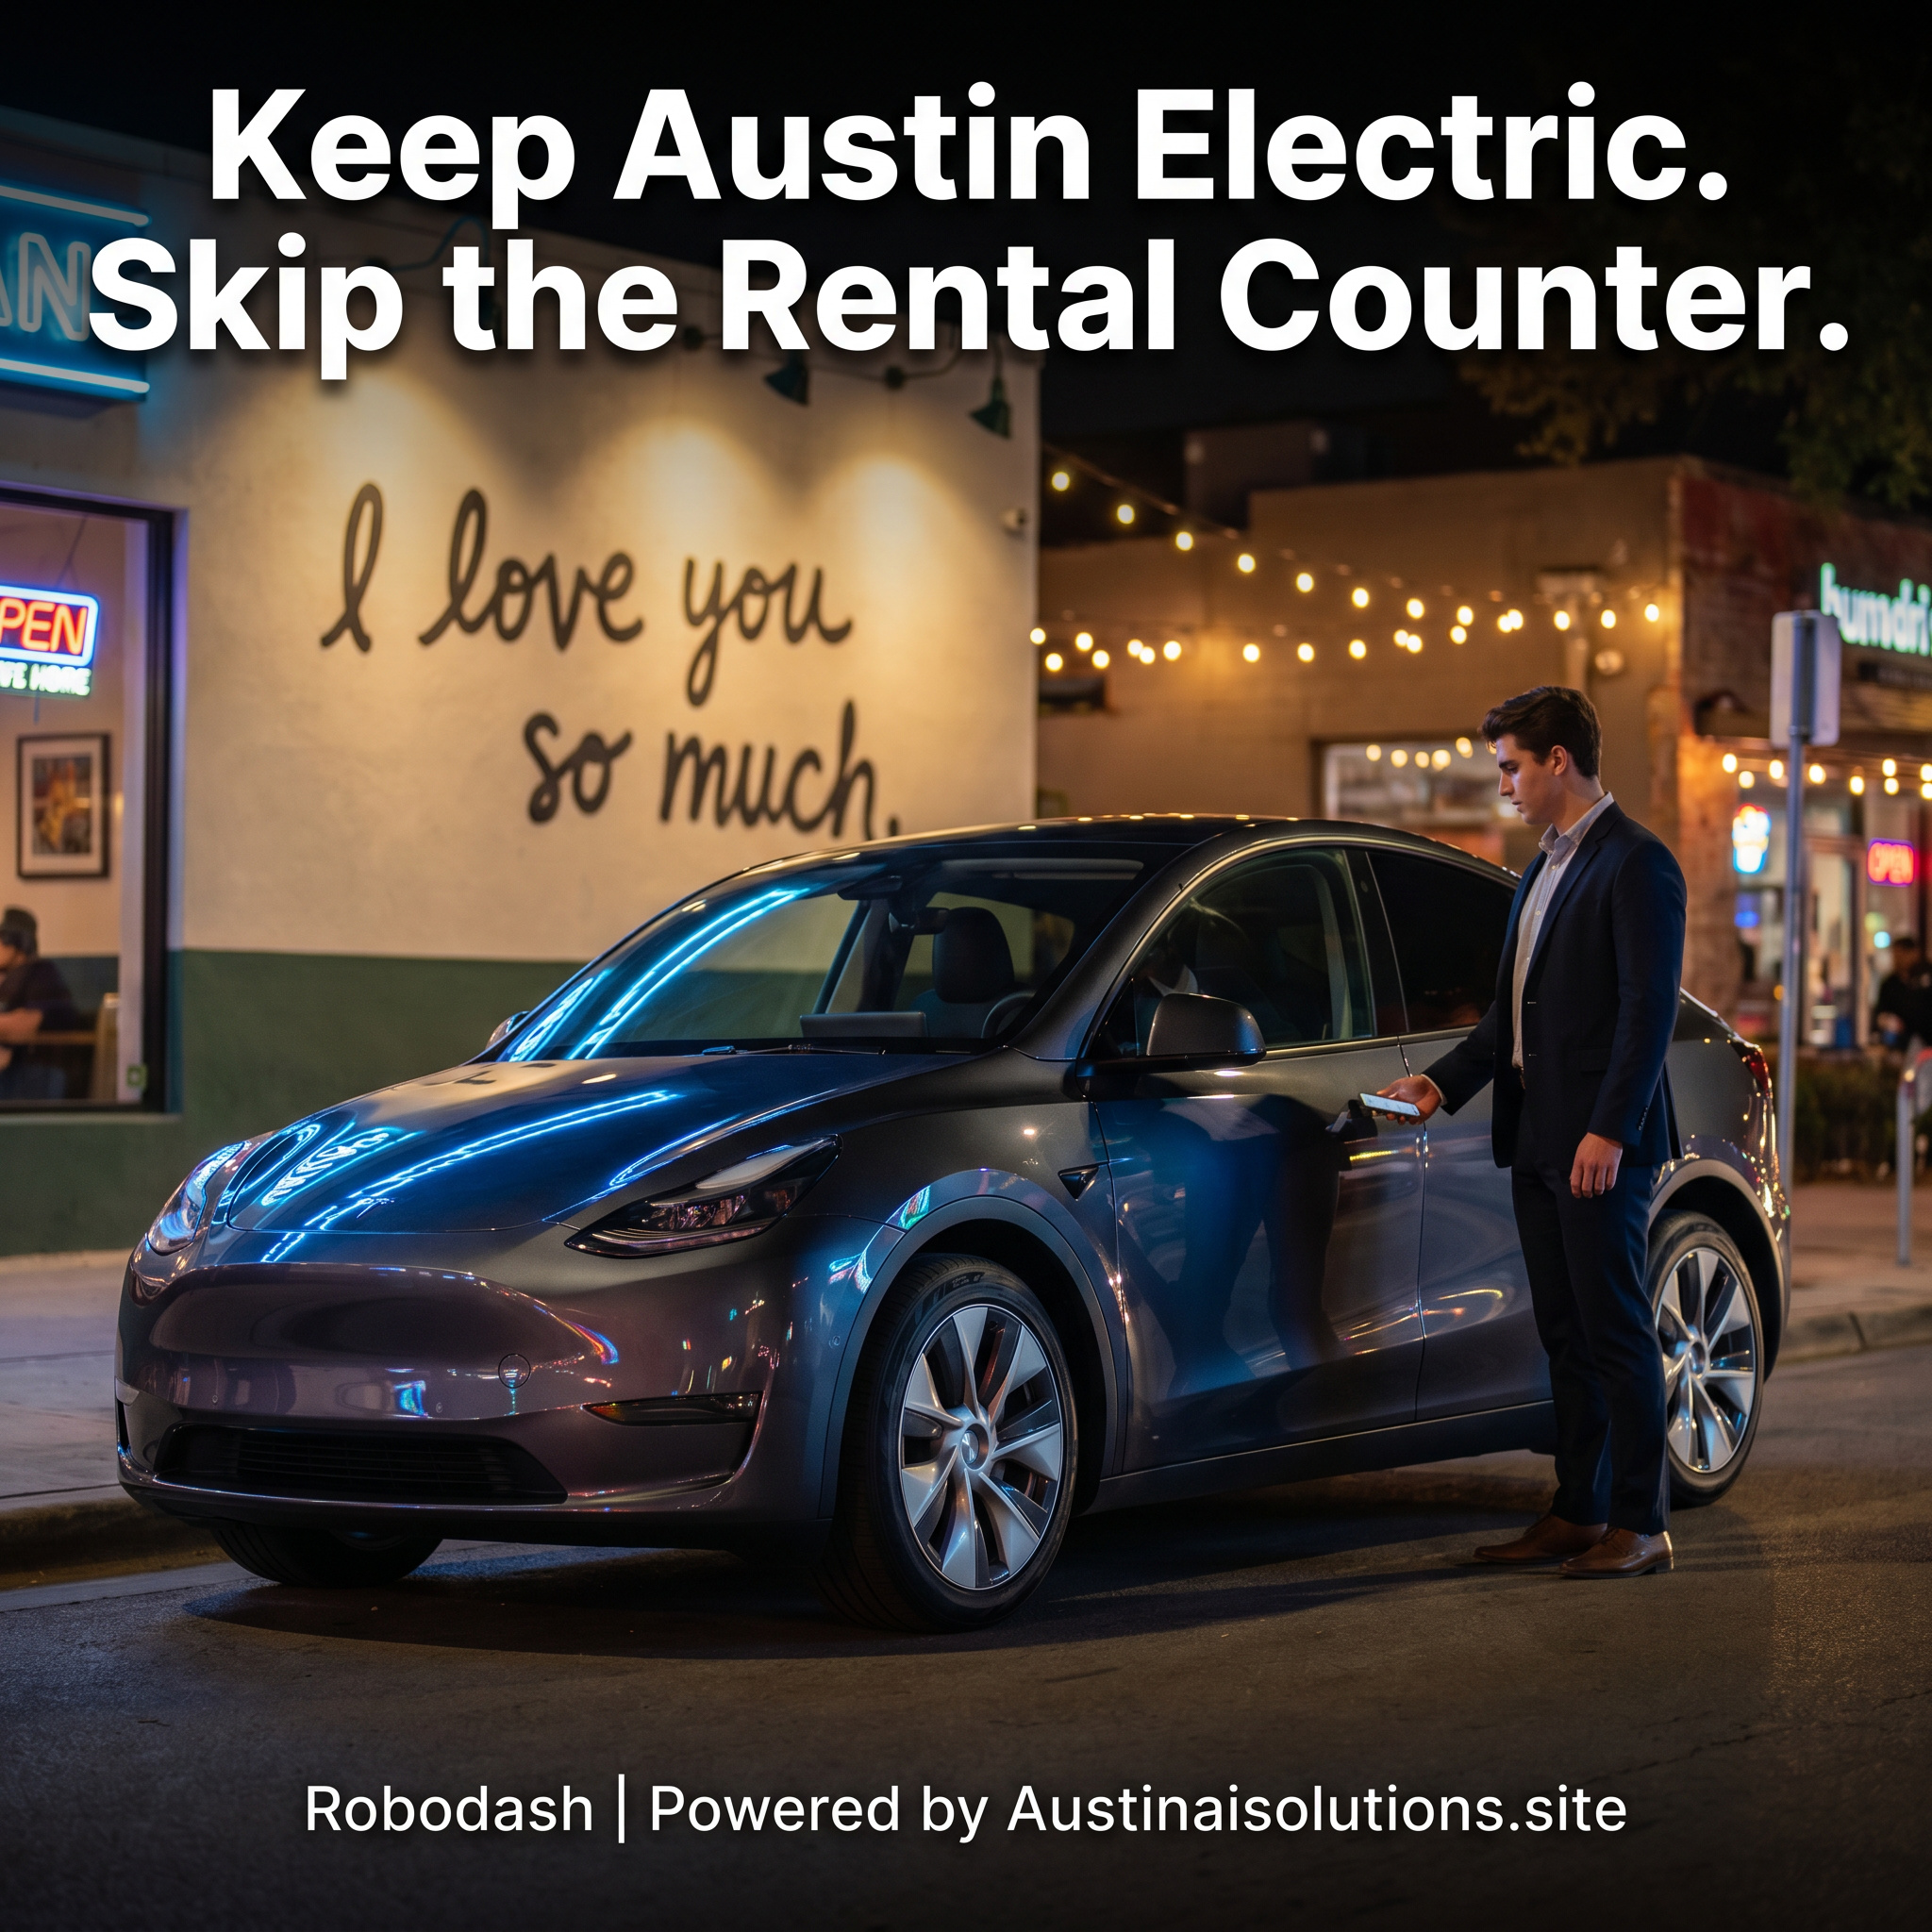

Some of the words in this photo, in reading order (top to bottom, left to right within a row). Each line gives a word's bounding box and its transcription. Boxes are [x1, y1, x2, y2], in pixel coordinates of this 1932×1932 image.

[417, 487, 644, 652] love
[684, 557, 853, 708] you
[1821, 562, 1932, 658] humdri
[523, 711, 633, 825] so
